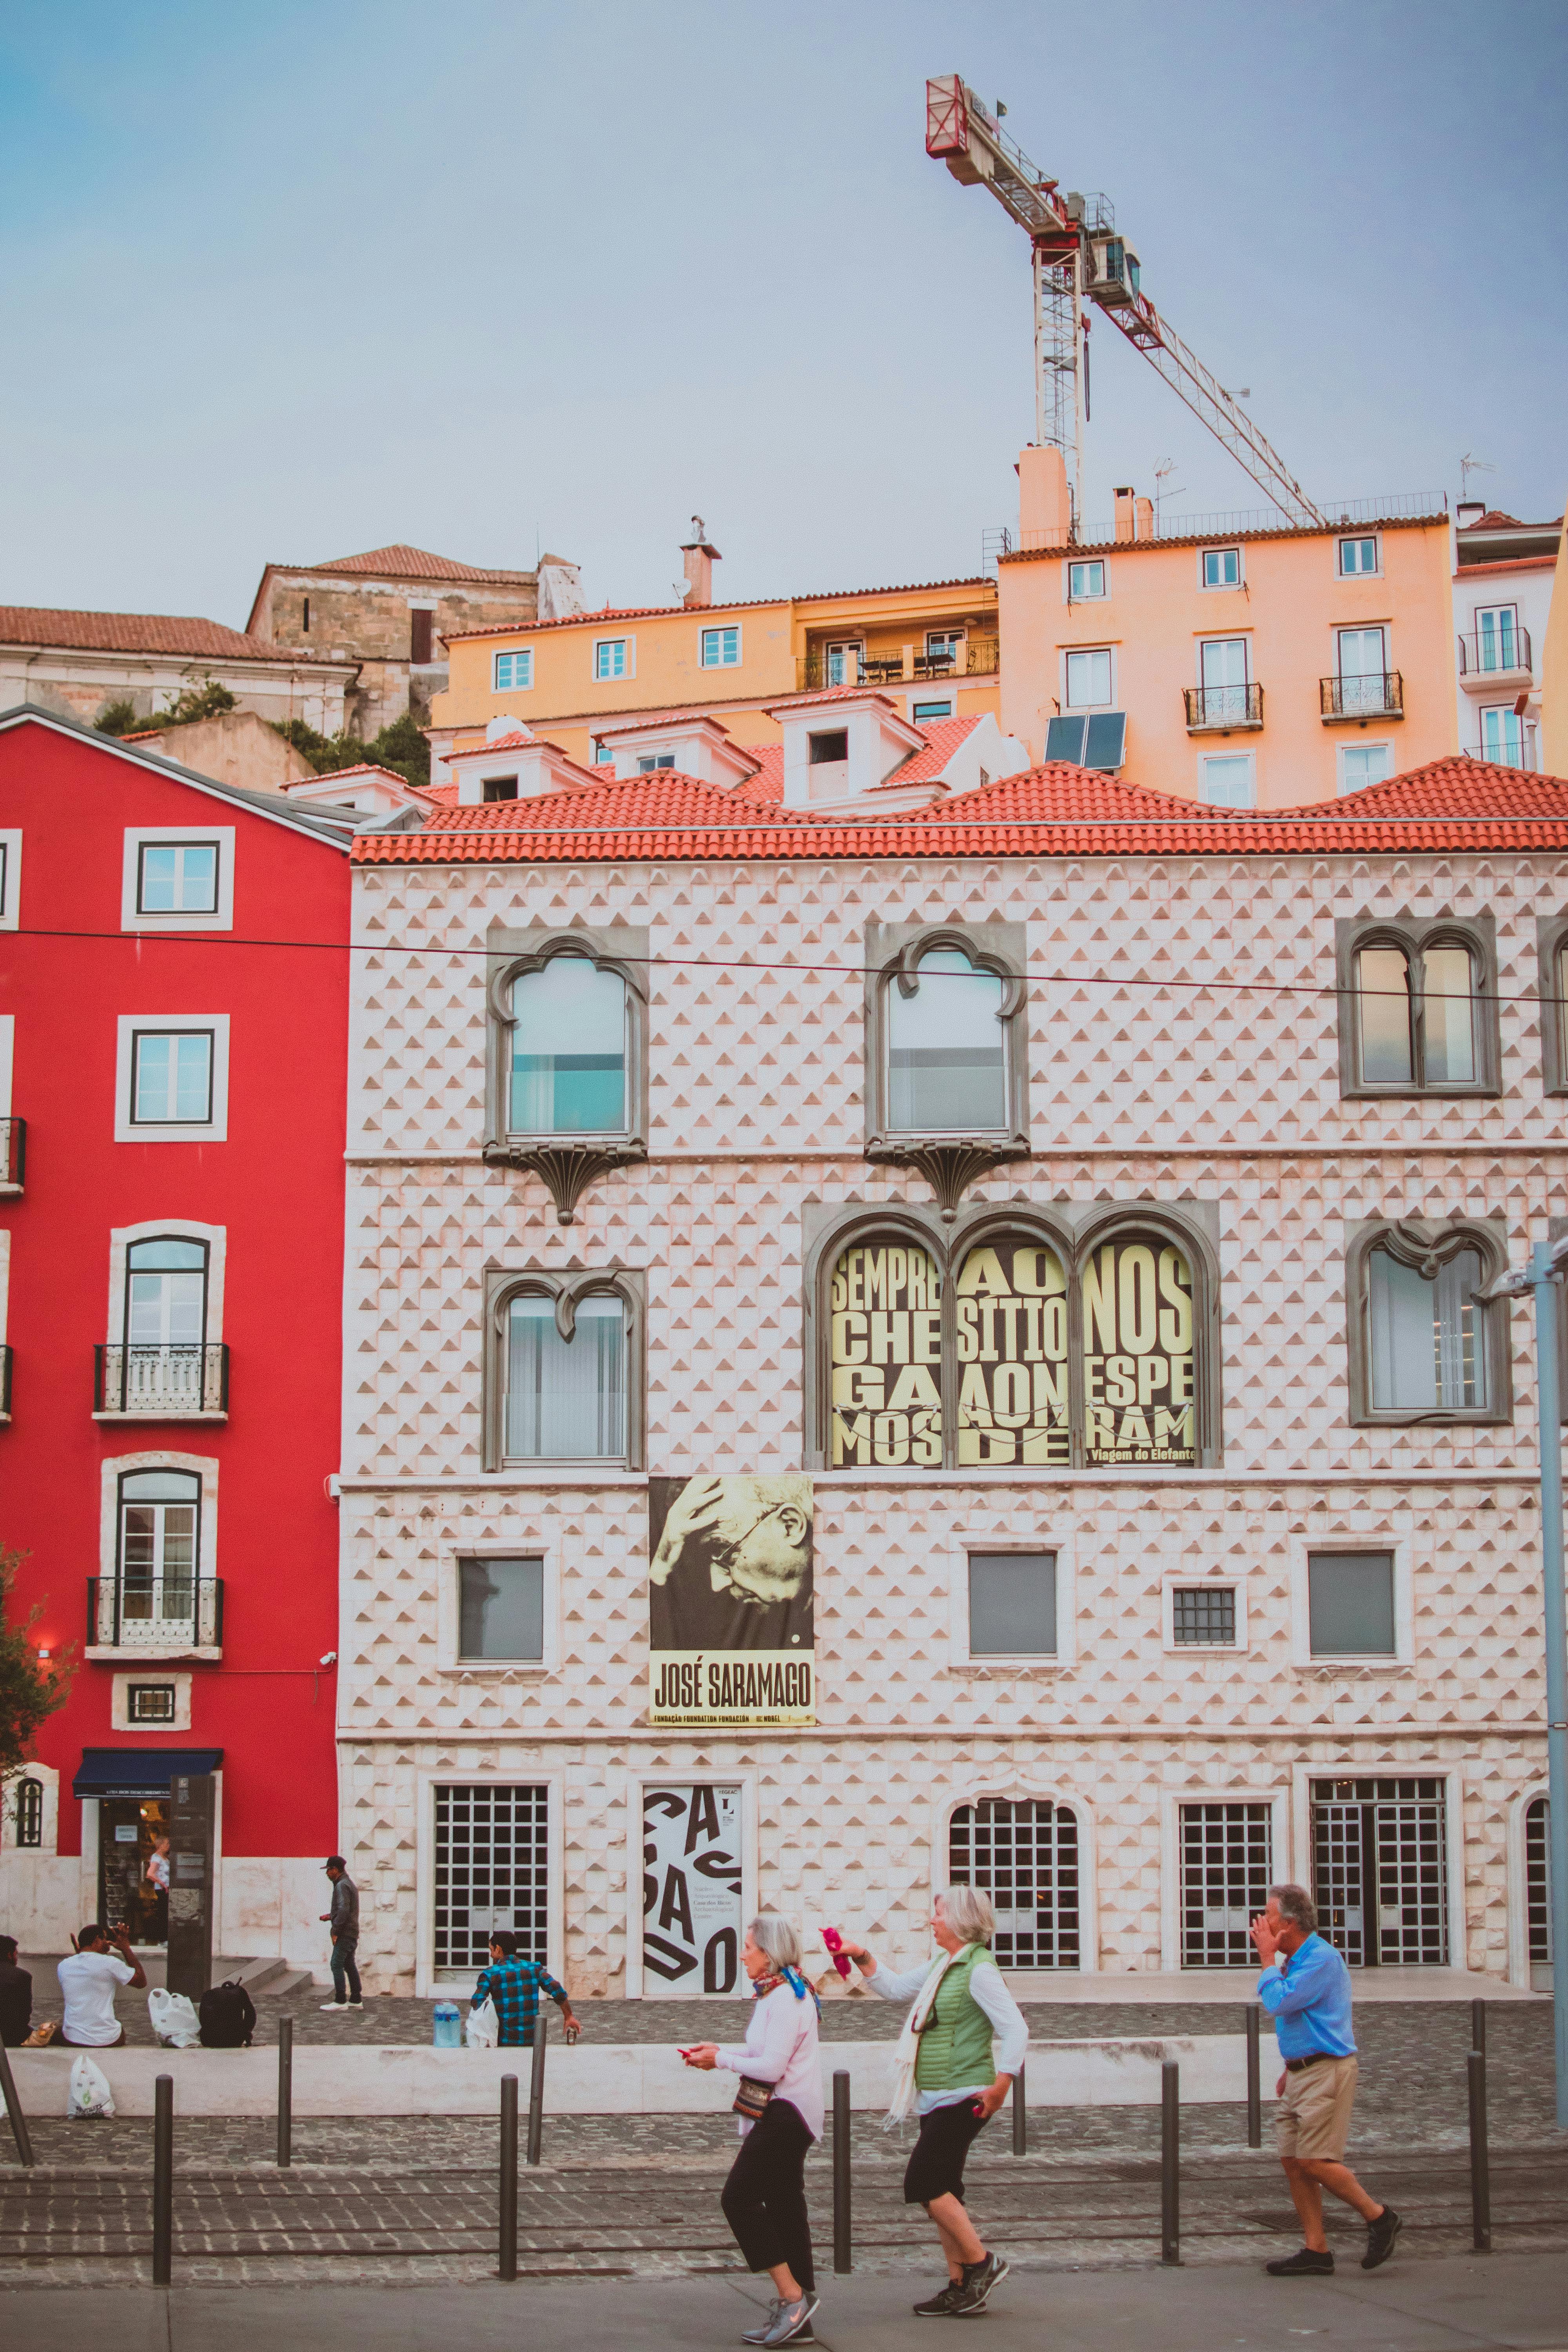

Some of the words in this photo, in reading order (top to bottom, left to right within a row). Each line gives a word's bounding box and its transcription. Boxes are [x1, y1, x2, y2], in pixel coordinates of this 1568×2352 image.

[832, 1248, 940, 1311] SEMPRE
[957, 1247, 1066, 1295] AO
[1083, 1245, 1192, 1354] NOS
[833, 1311, 941, 1365] CHE
[833, 1365, 941, 1410] GA
[958, 1363, 1069, 1427] AON
[1085, 1356, 1193, 1406] ESPE
[833, 1411, 942, 1465] MOS
[959, 1428, 1069, 1465] DE
[1085, 1406, 1194, 1448] RAM
[1092, 1448, 1132, 1463] Viagem
[1135, 1448, 1148, 1460] do
[655, 1655, 703, 1707] JOSÉ
[709, 1662, 811, 1707] SARAMAGO
[655, 1714, 682, 1723] FUNDAÇÃO
[719, 1713, 749, 1722] FUNDACIÓN
